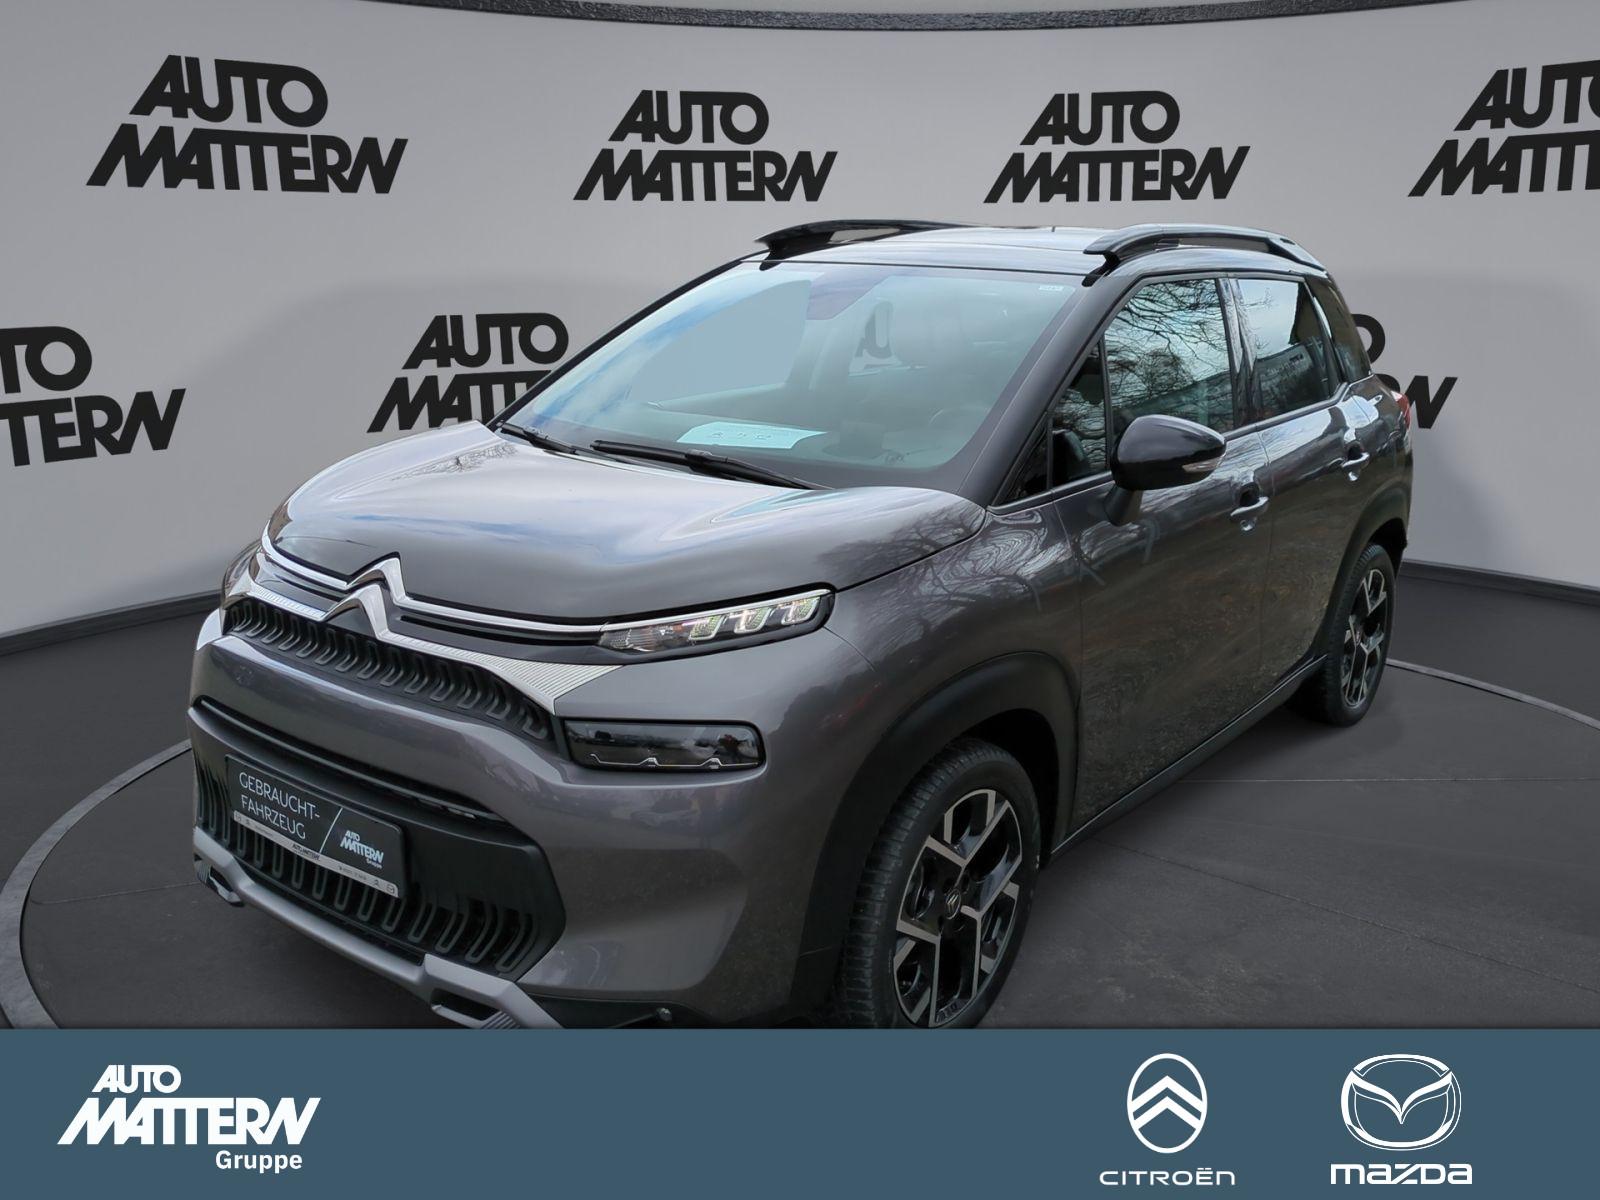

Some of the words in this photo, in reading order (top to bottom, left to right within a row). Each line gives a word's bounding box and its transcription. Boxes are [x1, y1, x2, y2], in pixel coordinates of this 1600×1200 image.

[129, 54, 328, 127] AUTO
[608, 89, 769, 145] AUTO
[1020, 90, 1180, 146] AUTO
[1453, 60, 1600, 131] AUT
[86, 122, 408, 194] MATTERN
[574, 149, 837, 202] MATTERN
[984, 146, 1250, 204] MATTERN
[1408, 130, 1600, 197] MATT
[0, 326, 92, 394] TO
[401, 312, 569, 370] AUTO
[0, 388, 186, 467] TERN
[366, 370, 551, 433] MATT
[239, 772, 320, 820] GEBRAUCHT-
[241, 794, 306, 840] FAHRZEUG
[340, 836, 384, 863] MATTERN
[344, 829, 361, 842] AUTO
